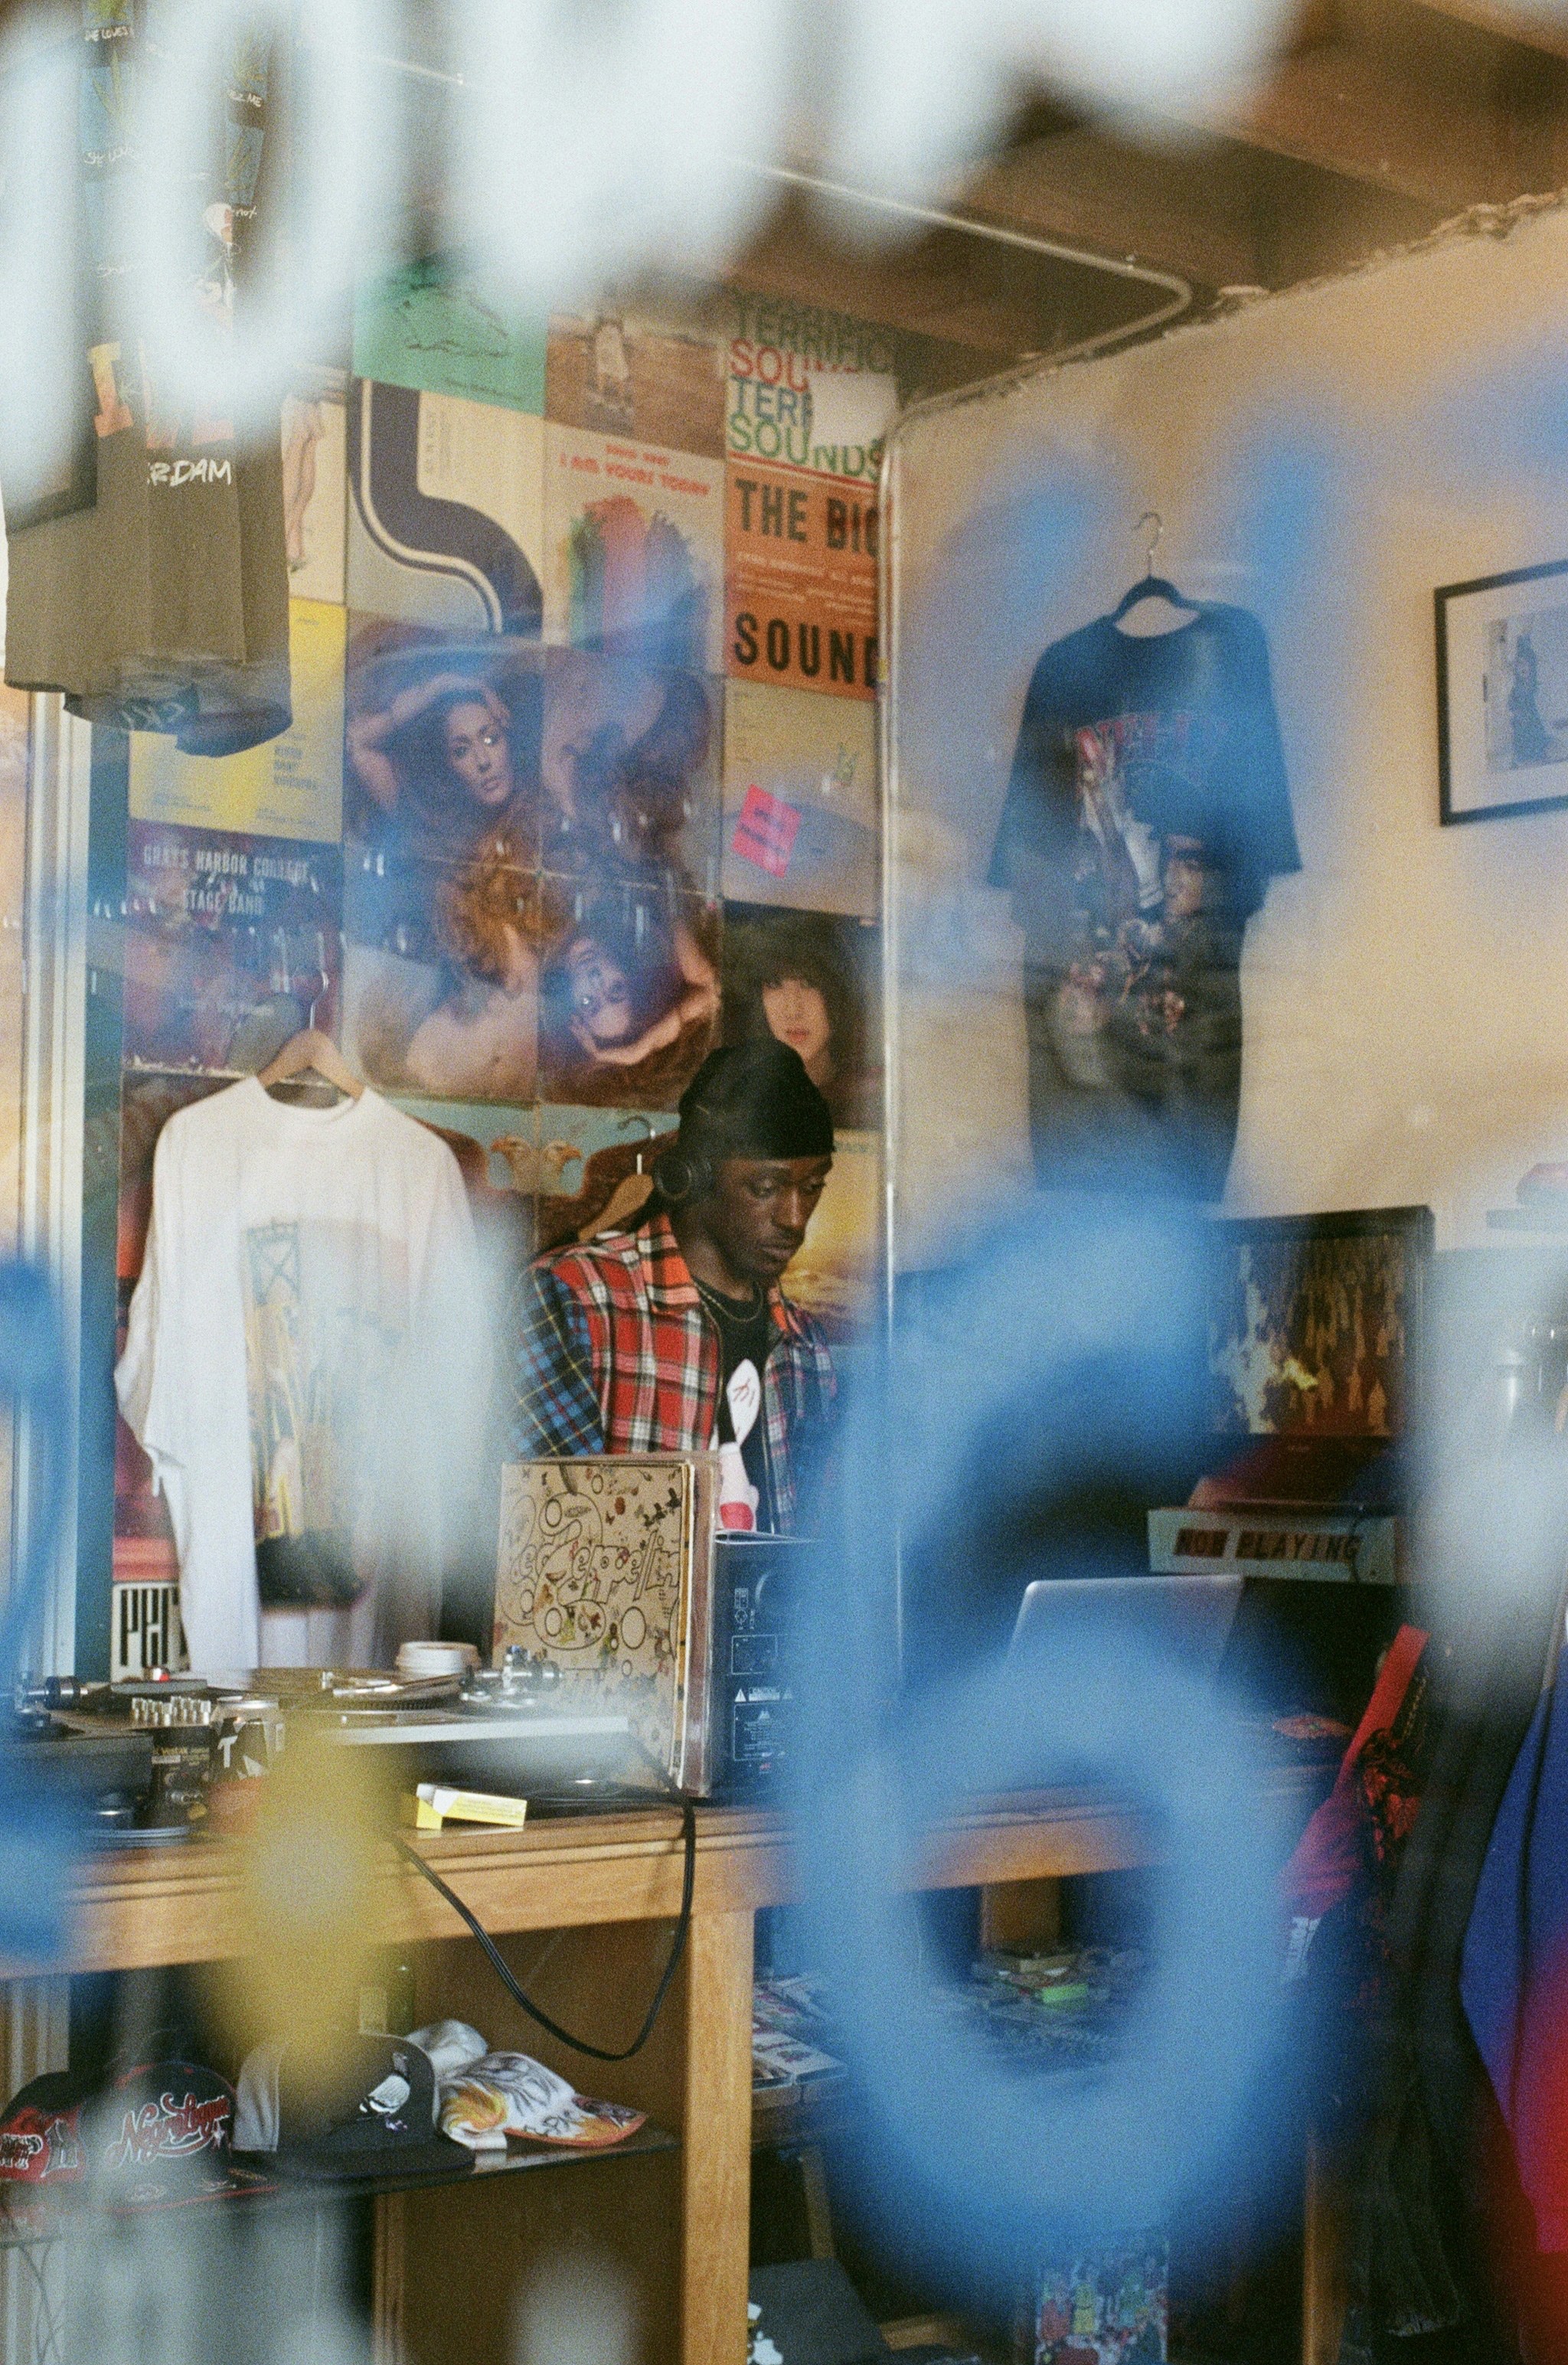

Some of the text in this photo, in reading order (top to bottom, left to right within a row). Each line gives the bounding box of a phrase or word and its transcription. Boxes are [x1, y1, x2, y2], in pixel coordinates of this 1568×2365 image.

[147, 458, 233, 488] RDAM
[734, 478, 808, 544] THE
[194, 848, 248, 876] HARBOR
[1174, 1529, 1361, 1560] NOW PLAYING
